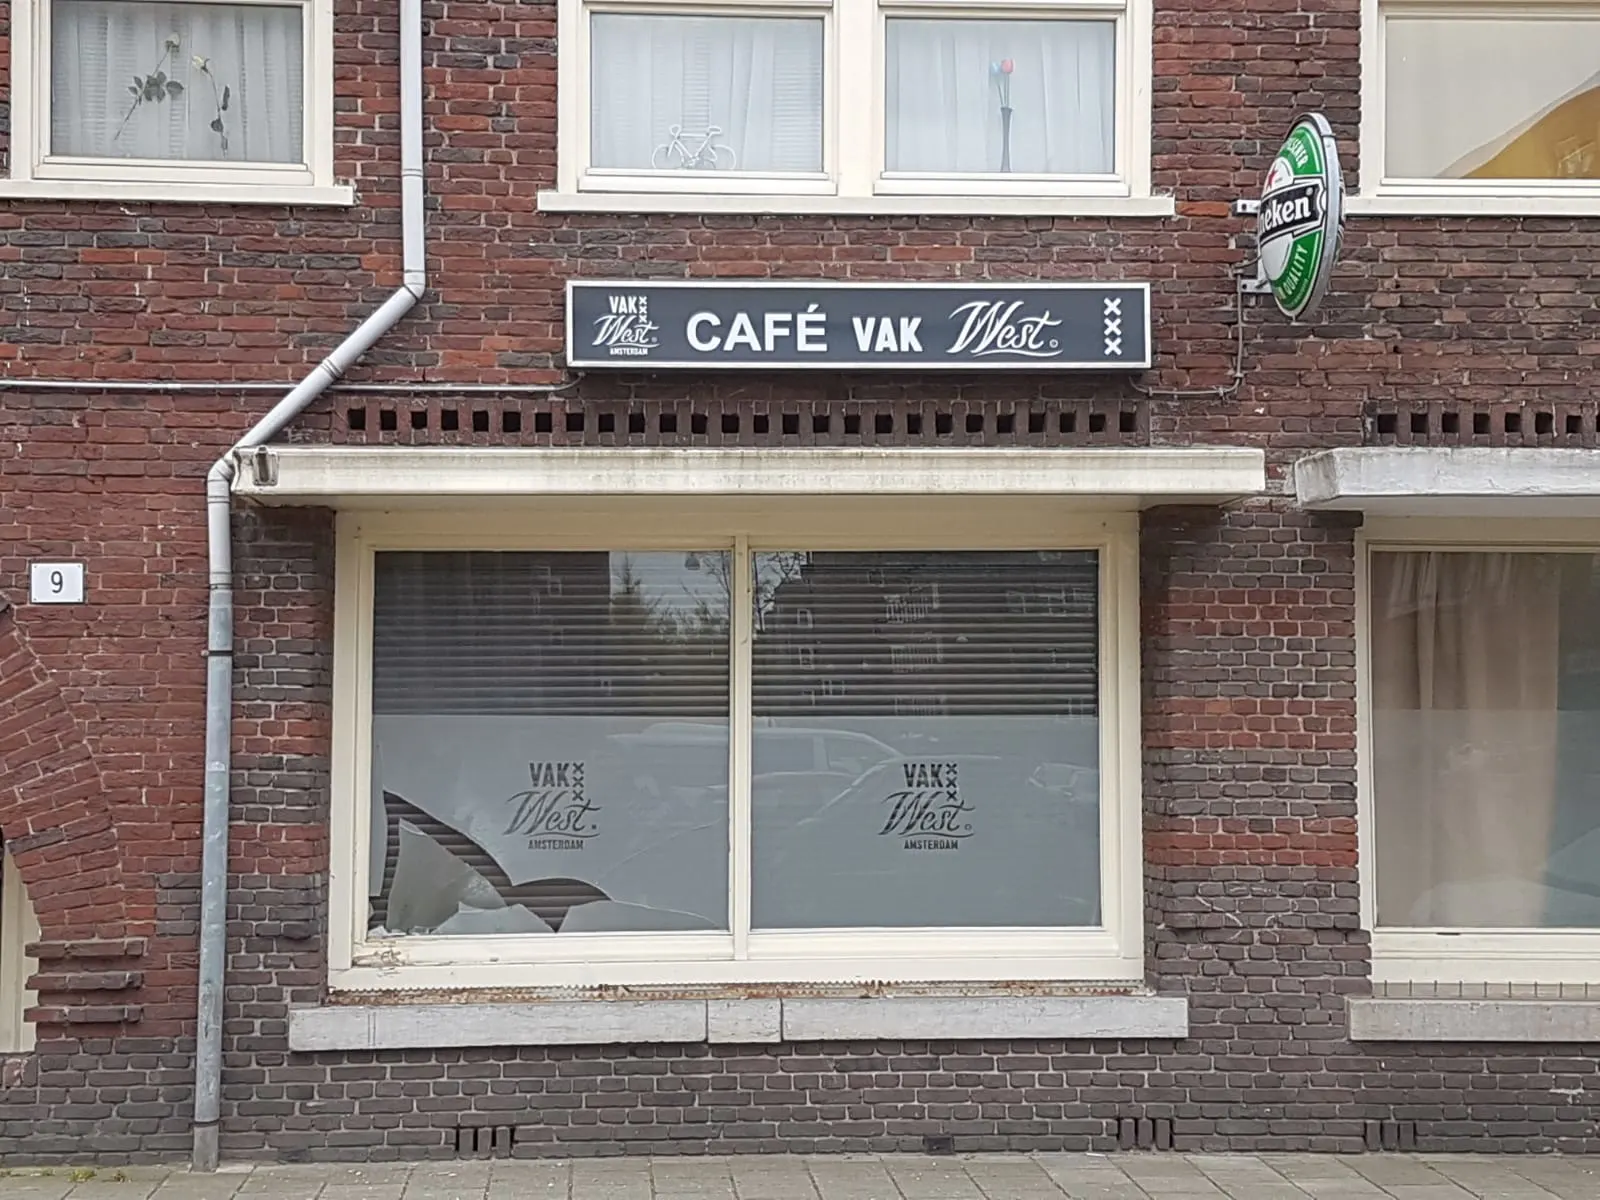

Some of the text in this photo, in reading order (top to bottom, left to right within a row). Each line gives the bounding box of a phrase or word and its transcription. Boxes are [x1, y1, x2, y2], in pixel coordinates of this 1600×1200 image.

[1282, 244, 1308, 295] QUALITY
[609, 296, 637, 314] VAK
[686, 303, 828, 352] CAFÉ
[852, 316, 923, 352] VAK
[51, 570, 64, 594] 9
[529, 762, 570, 788] VAK
[903, 763, 944, 788] VAK
[527, 839, 584, 850] AMSTERDAM
[903, 839, 959, 850] AMSTERDAM
